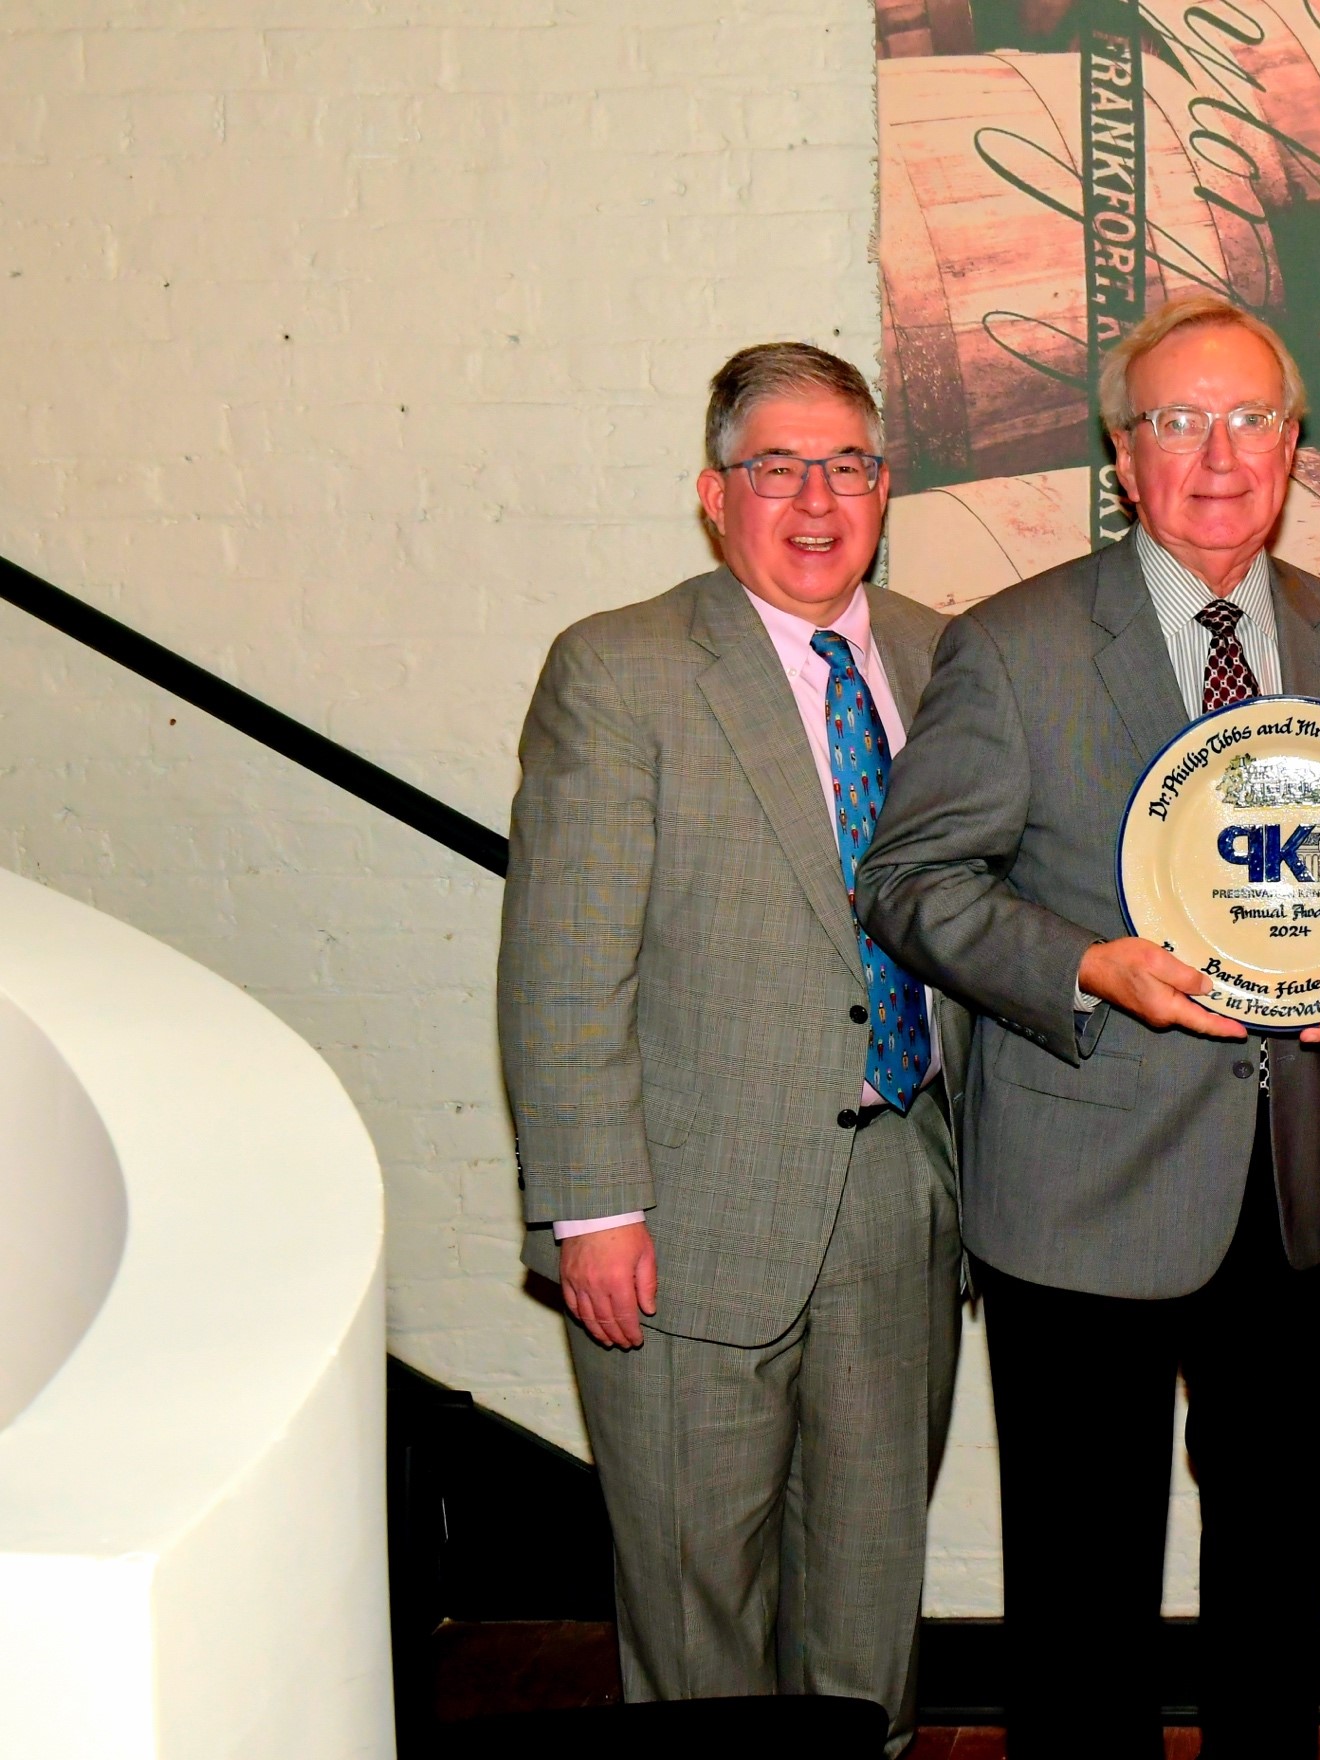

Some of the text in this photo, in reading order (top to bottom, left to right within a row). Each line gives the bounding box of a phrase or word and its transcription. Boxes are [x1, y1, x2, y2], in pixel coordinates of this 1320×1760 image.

[1162, 749, 1209, 798] Phillip
[1206, 725, 1252, 754] Tibbs
[1256, 716, 1293, 736] and
[1229, 903, 1288, 924] Annual
[1269, 925, 1312, 938] 2024
[1200, 957, 1270, 995] Barbara
[1225, 993, 1243, 1010] in
